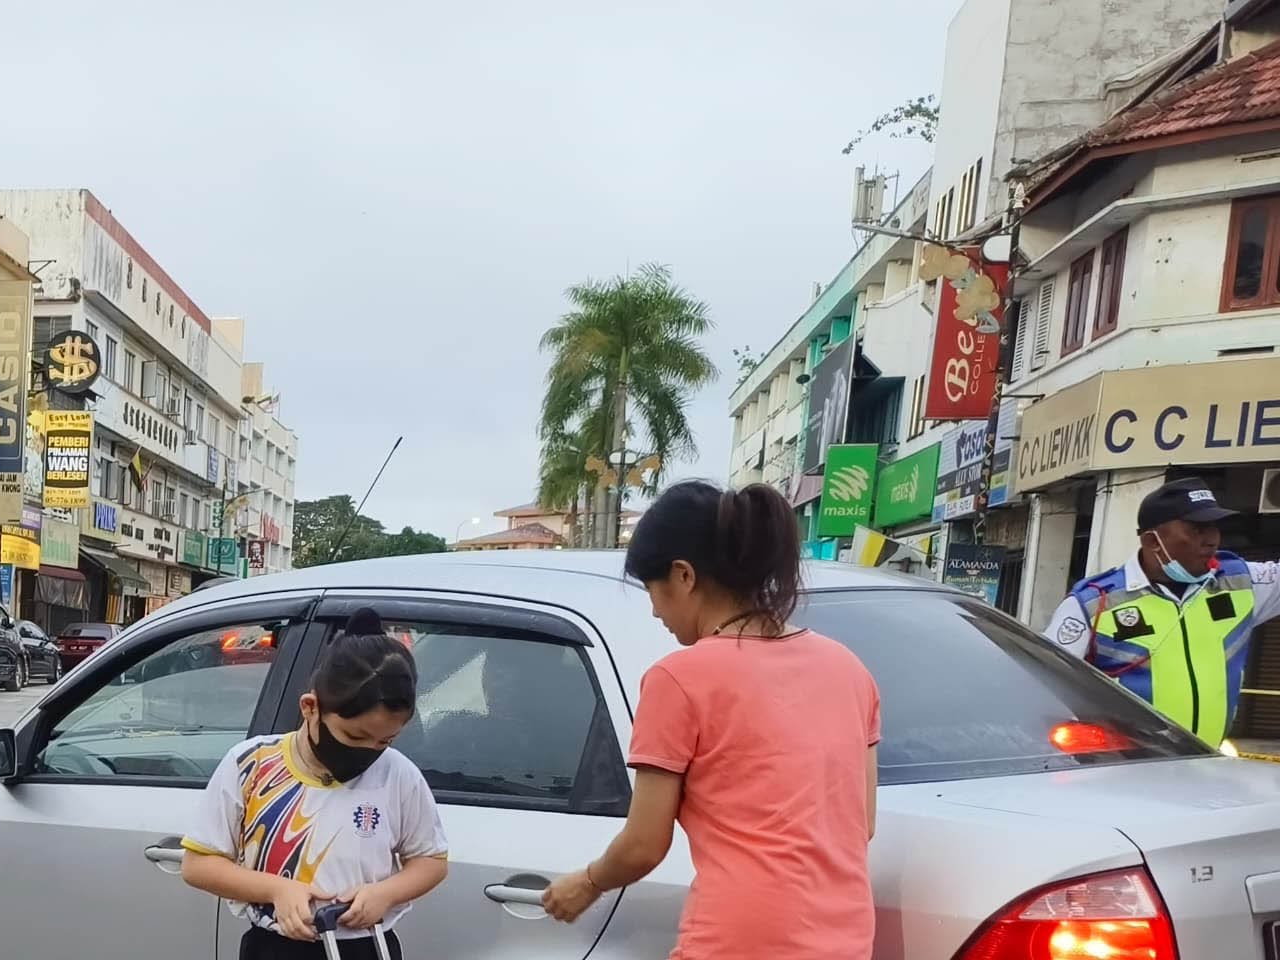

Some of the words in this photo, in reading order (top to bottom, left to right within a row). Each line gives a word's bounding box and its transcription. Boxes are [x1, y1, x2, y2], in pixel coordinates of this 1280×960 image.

[970, 334, 986, 395] COLLE
[1104, 409, 1138, 454] C
[1154, 405, 1189, 451] C
[47, 436, 89, 447] PEMBERI
[1019, 441, 1030, 480] C
[1030, 435, 1041, 477] C
[1040, 421, 1073, 473] LIEW
[1072, 412, 1096, 463] KK
[47, 447, 88, 457] PINJAMAN
[47, 456, 88, 471] WANG
[6, 473, 18, 484] JAM
[46, 470, 87, 481] BERLESEN
[2, 483, 21, 494] KWONG
[824, 504, 867, 517] maxis
[947, 560, 1000, 570] ALAMANDA
